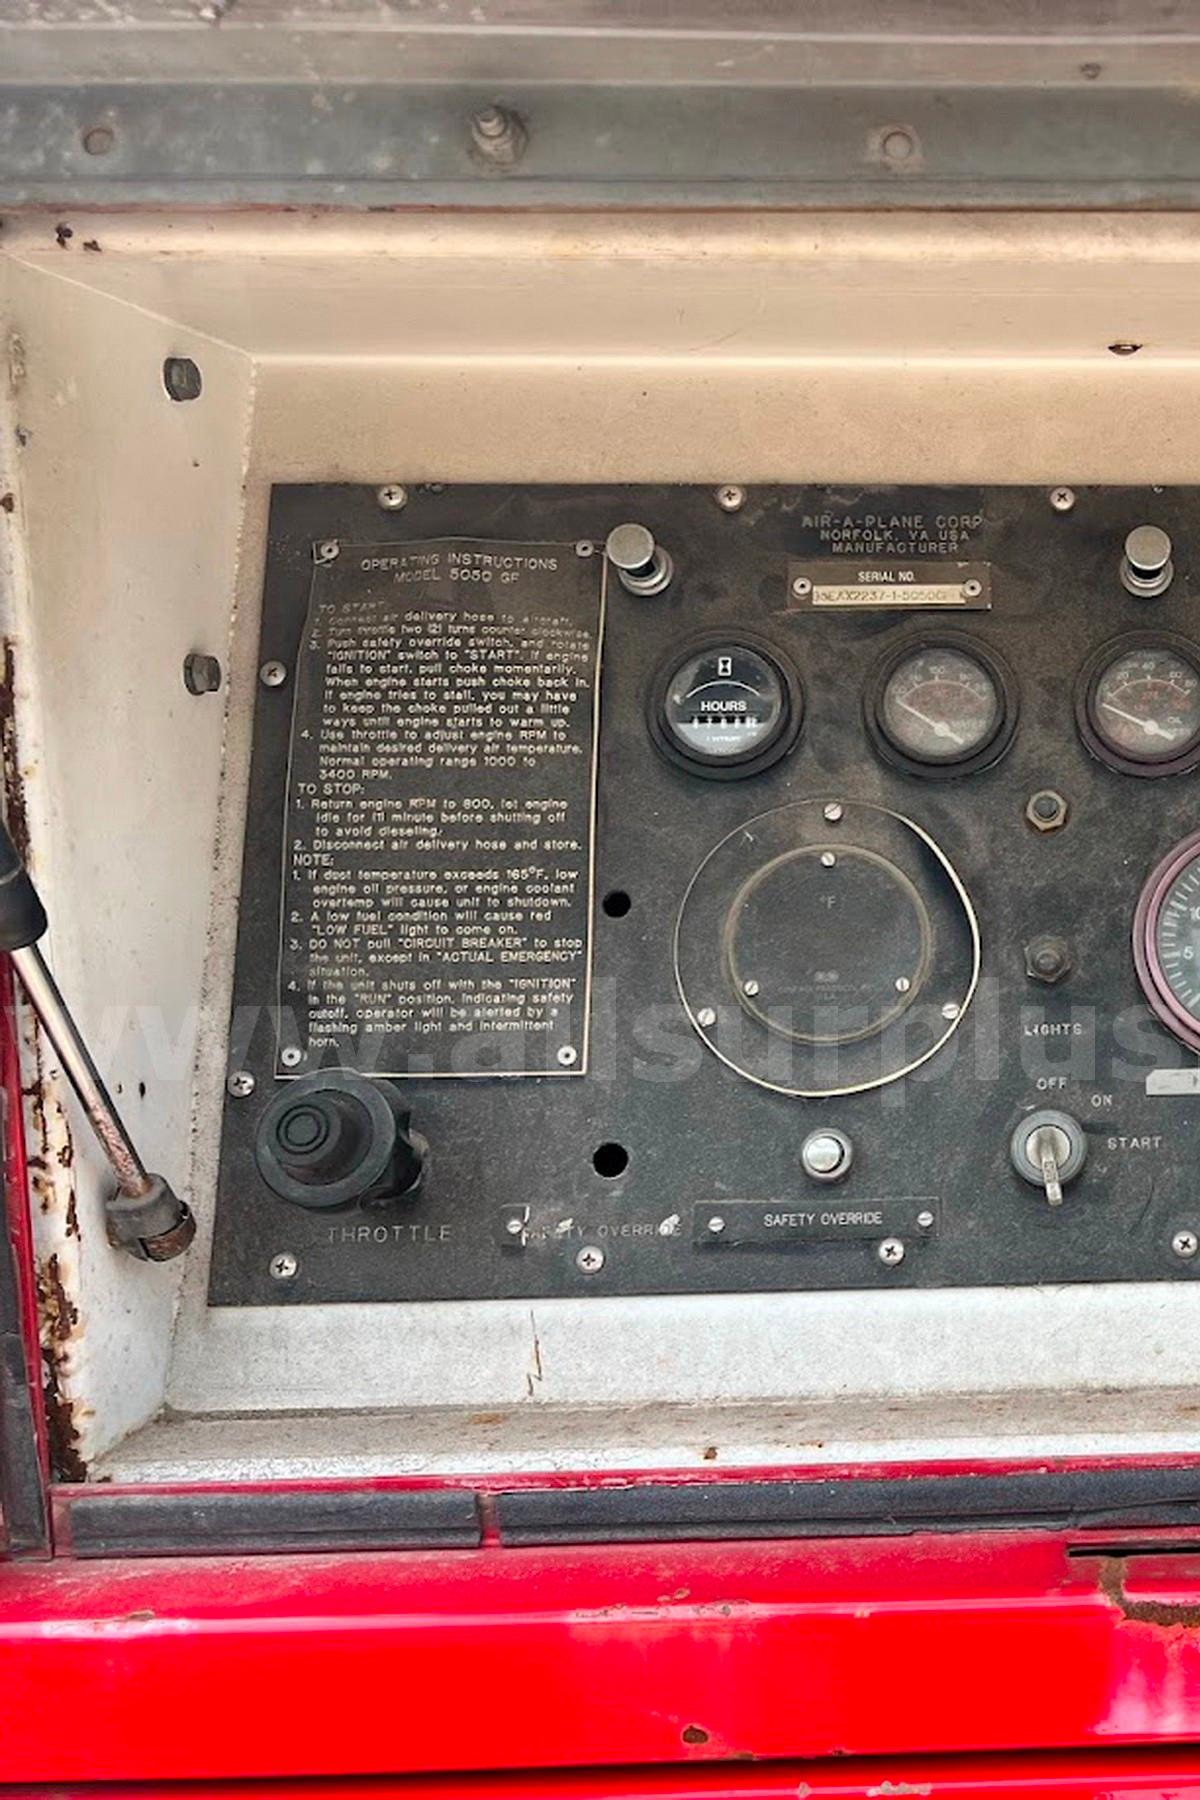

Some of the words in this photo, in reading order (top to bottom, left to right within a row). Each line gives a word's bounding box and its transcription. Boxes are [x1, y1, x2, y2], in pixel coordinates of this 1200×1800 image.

[801, 515, 924, 528] AIR-A-PLANE
[909, 530, 929, 541] VA
[939, 530, 970, 541] USA
[832, 542, 959, 553] MANUFACTURER
[361, 554, 439, 570] OPERATING
[449, 553, 557, 570] INSTRUCTIONS
[450, 568, 492, 582] 5050
[858, 571, 895, 583] SERIAL
[898, 571, 915, 582] NO.
[405, 611, 457, 623] delivery
[464, 612, 494, 621] hose
[402, 625, 422, 634] two
[449, 625, 475, 634] turns
[362, 638, 400, 648] safety
[409, 637, 461, 647] override
[521, 640, 543, 650] and
[398, 651, 440, 661] switch
[546, 653, 588, 662] engine
[327, 664, 353, 674] fails
[419, 665, 442, 674] pull
[449, 664, 486, 673] choke
[326, 677, 359, 686] When
[365, 678, 407, 688] engine
[414, 677, 448, 686] starts
[456, 677, 485, 688] push
[492, 677, 530, 687] choke
[538, 677, 567, 687] back
[340, 692, 381, 702] engine
[388, 690, 416, 700] tries
[482, 692, 505, 701] you
[513, 692, 539, 702] may
[546, 691, 576, 700] have
[343, 704, 374, 715] keep
[408, 704, 446, 713] choke
[453, 704, 492, 714] pulled
[500, 705, 519, 713] out
[541, 705, 570, 713] little
[700, 700, 747, 712] HOURS
[323, 718, 356, 728] ways
[363, 717, 390, 726] until
[397, 718, 438, 728] engine
[446, 717, 482, 727] starts
[509, 718, 542, 727] warm
[321, 730, 344, 740] Use
[351, 730, 397, 740] throttle
[424, 730, 463, 741] adjust
[470, 732, 512, 741] engine
[520, 730, 546, 740] RPM
[319, 743, 369, 753] maintain
[376, 743, 421, 753] desired
[428, 744, 476, 754] delivery
[484, 744, 499, 753] air
[319, 757, 364, 766] Normal
[372, 757, 433, 768] operating
[440, 757, 476, 768] range
[484, 757, 515, 766] 1000
[323, 784, 365, 794] STOP:
[311, 799, 352, 809] Return
[359, 800, 402, 810] engine
[409, 799, 436, 809] RPM
[524, 800, 567, 810] engine
[316, 813, 340, 823] idle
[348, 813, 365, 823] for
[391, 813, 434, 822] minute
[441, 813, 482, 822] before
[490, 813, 540, 824] shutting
[548, 813, 565, 822] off
[336, 826, 372, 836] avoid
[314, 840, 384, 850] Disconnect
[391, 841, 408, 850] air
[416, 840, 469, 851] delivery
[476, 840, 507, 850] hose
[514, 841, 537, 850] and
[293, 855, 334, 866] NOTE:
[358, 870, 437, 881] temperature
[445, 870, 498, 879] exceeds
[555, 870, 578, 879] low
[313, 884, 356, 895] engine
[364, 883, 379, 894] oil
[475, 884, 518, 895] engine
[526, 884, 574, 894] coolant
[313, 897, 374, 909] overtemp
[381, 897, 403, 907] will
[411, 898, 448, 907] cause
[456, 897, 479, 907] unit
[327, 911, 349, 921] low
[357, 911, 381, 921] fuel
[388, 911, 447, 921] condition
[454, 912, 477, 921] will
[485, 912, 523, 921] cause
[530, 912, 550, 921] red
[401, 924, 428, 936] light
[456, 926, 490, 935] come
[334, 939, 359, 948] NOT
[367, 939, 391, 949] pull
[554, 939, 582, 949] stop
[369, 953, 412, 964] except
[1183, 946, 1194, 960] 5
[351, 980, 374, 989] unit
[382, 980, 416, 989] shuts
[448, 979, 474, 989] with
[462, 994, 525, 1004] indicating
[532, 994, 573, 1004] safety
[356, 1010, 414, 1019] operator
[421, 1008, 443, 1018] will
[474, 1008, 520, 1018] alerted
[309, 1022, 357, 1033] flashing
[365, 1022, 406, 1032] amber
[414, 1022, 441, 1033] light
[479, 1021, 554, 1031] intermittent
[1024, 1023, 1083, 1036] LIGHTS
[1036, 1077, 1068, 1090] OFF
[1091, 1094, 1113, 1107] ON
[1107, 1136, 1163, 1150] START
[763, 1213, 816, 1227] SAFETY
[820, 1211, 883, 1226] OVERRIDE
[327, 1224, 452, 1243] THROTTLE
